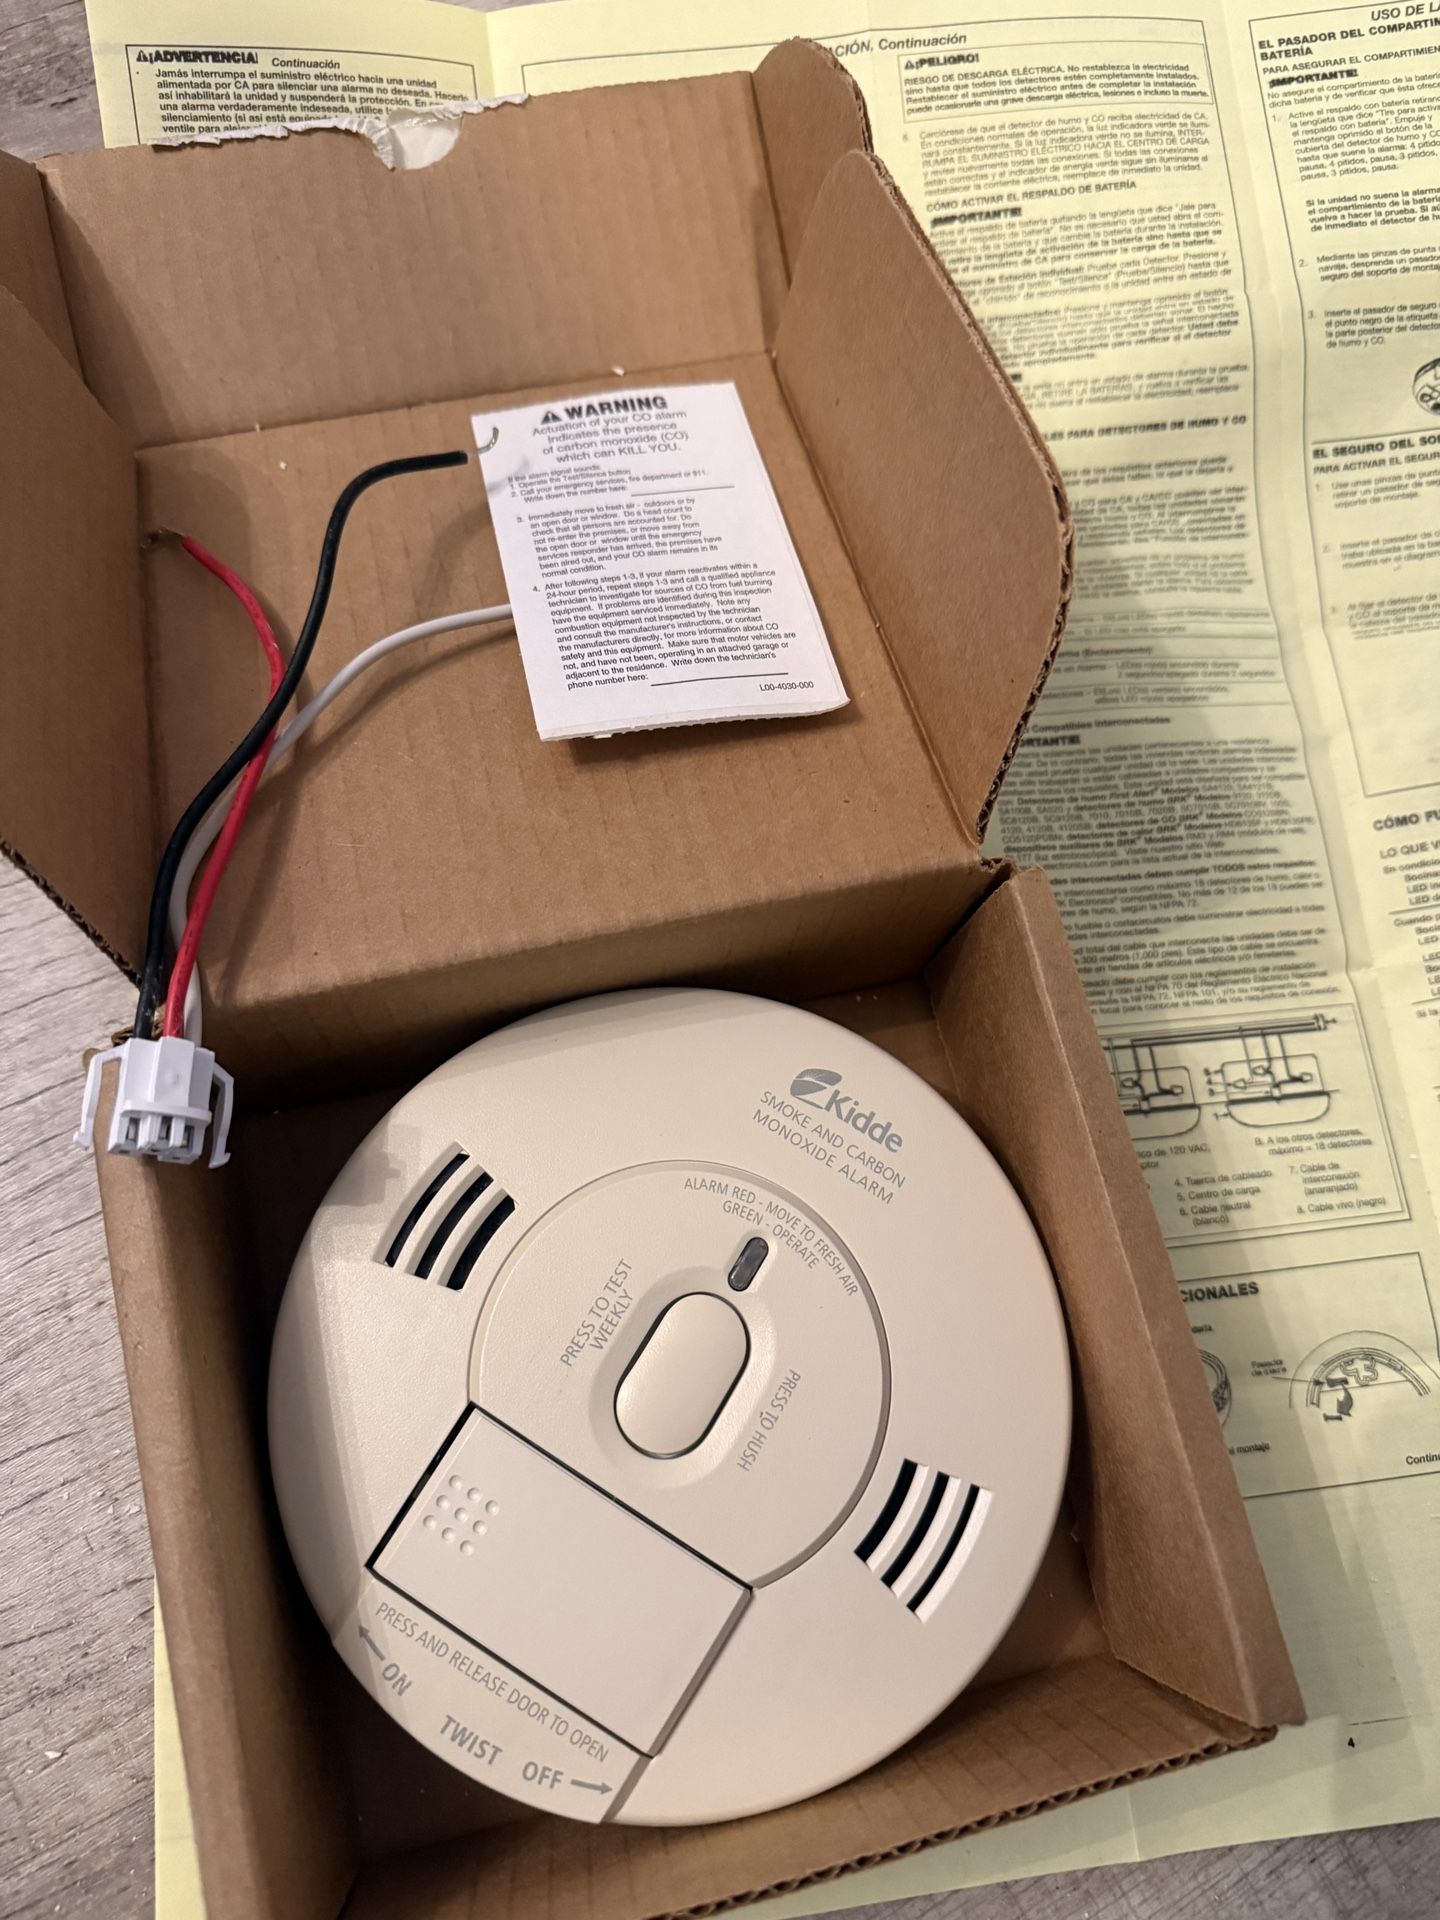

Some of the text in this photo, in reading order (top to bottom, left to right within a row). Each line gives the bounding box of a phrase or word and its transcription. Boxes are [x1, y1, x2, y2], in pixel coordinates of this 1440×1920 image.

[878, 33, 967, 50] Continuación
[1278, 31, 1337, 47] PASADOR
[271, 57, 340, 70] Continuación
[1260, 46, 1313, 61] BATERÍA
[155, 68, 437, 89] Jamás interrumpa el suministro eléctrico hacia una unidad
[157, 80, 212, 89] alimentada
[214, 82, 231, 91] por
[234, 80, 250, 90] CA
[252, 82, 274, 91] para
[277, 81, 317, 91] silenciar
[320, 83, 339, 92] una
[341, 84, 374, 94] alarma
[376, 87, 388, 95] no
[158, 90, 173, 100] así
[175, 90, 231, 101] inhabilitará
[233, 91, 242, 101] la
[245, 91, 279, 101] unidad
[281, 94, 287, 102] y
[290, 92, 346, 103] suspenderá
[348, 94, 356, 103] la
[159, 103, 178, 111] una
[181, 102, 215, 111] alarma
[218, 102, 297, 112] verdaderamente
[355, 106, 384, 115] utilice
[161, 113, 232, 122] silenciamiento
[235, 113, 246, 124] (si
[249, 113, 263, 122] así
[162, 124, 196, 133] ventile
[564, 395, 668, 420] WARNING
[532, 410, 687, 437] Actuation of your CO alarm
[602, 425, 621, 436] the
[624, 422, 677, 436] presence
[542, 431, 689, 456] of carbon monoxide (CO)
[555, 452, 591, 464] which
[593, 449, 616, 459] can
[617, 446, 647, 456] KILL
[560, 651, 585, 662] safety
[587, 648, 603, 657] and
[604, 647, 619, 655] this
[668, 639, 690, 649] Make
[691, 637, 709, 645] sure
[710, 635, 726, 644] that
[727, 633, 749, 642] motor
[750, 631, 782, 641] vehicles
[580, 659, 596, 668] and
[597, 656, 618, 667] have
[619, 654, 632, 664] not
[658, 646, 696, 659] operating
[696, 646, 705, 655] in
[706, 646, 716, 654] an
[718, 642, 751, 652] attached
[752, 641, 779, 652] garage
[565, 669, 600, 682] adjacent
[601, 668, 610, 676] to
[611, 665, 624, 674] the
[670, 657, 693, 667] Write
[694, 654, 716, 664] down
[716, 652, 730, 662] the
[567, 673, 648, 691] phone number here:
[759, 680, 814, 692] L00-4030-000
[823, 1088, 903, 1153] Kidde
[760, 1090, 906, 1188] SMOKE AND CARBON
[752, 1108, 894, 1205] MONOXIDE ALARM
[684, 1177, 729, 1196] ALARM
[731, 1185, 756, 1204] RED
[765, 1200, 801, 1231] MOVE
[799, 1223, 816, 1242] TO
[813, 1238, 845, 1276] FRESH
[839, 1273, 859, 1296] AIR
[722, 1199, 764, 1226] GREEN
[772, 1224, 820, 1270] OPERATE
[560, 1258, 632, 1367] PRESS TO TEST
[589, 1288, 633, 1350] WEEKLY
[737, 1369, 801, 1472] PRESS TO HUSH
[375, 1601, 609, 1762] PRESS AND RELEASE DOOR TO OPEN
[381, 1662, 413, 1697] ON
[439, 1714, 503, 1766] TWIST
[1347, 1736, 1355, 1749] 4
[521, 1761, 564, 1790] OFF
